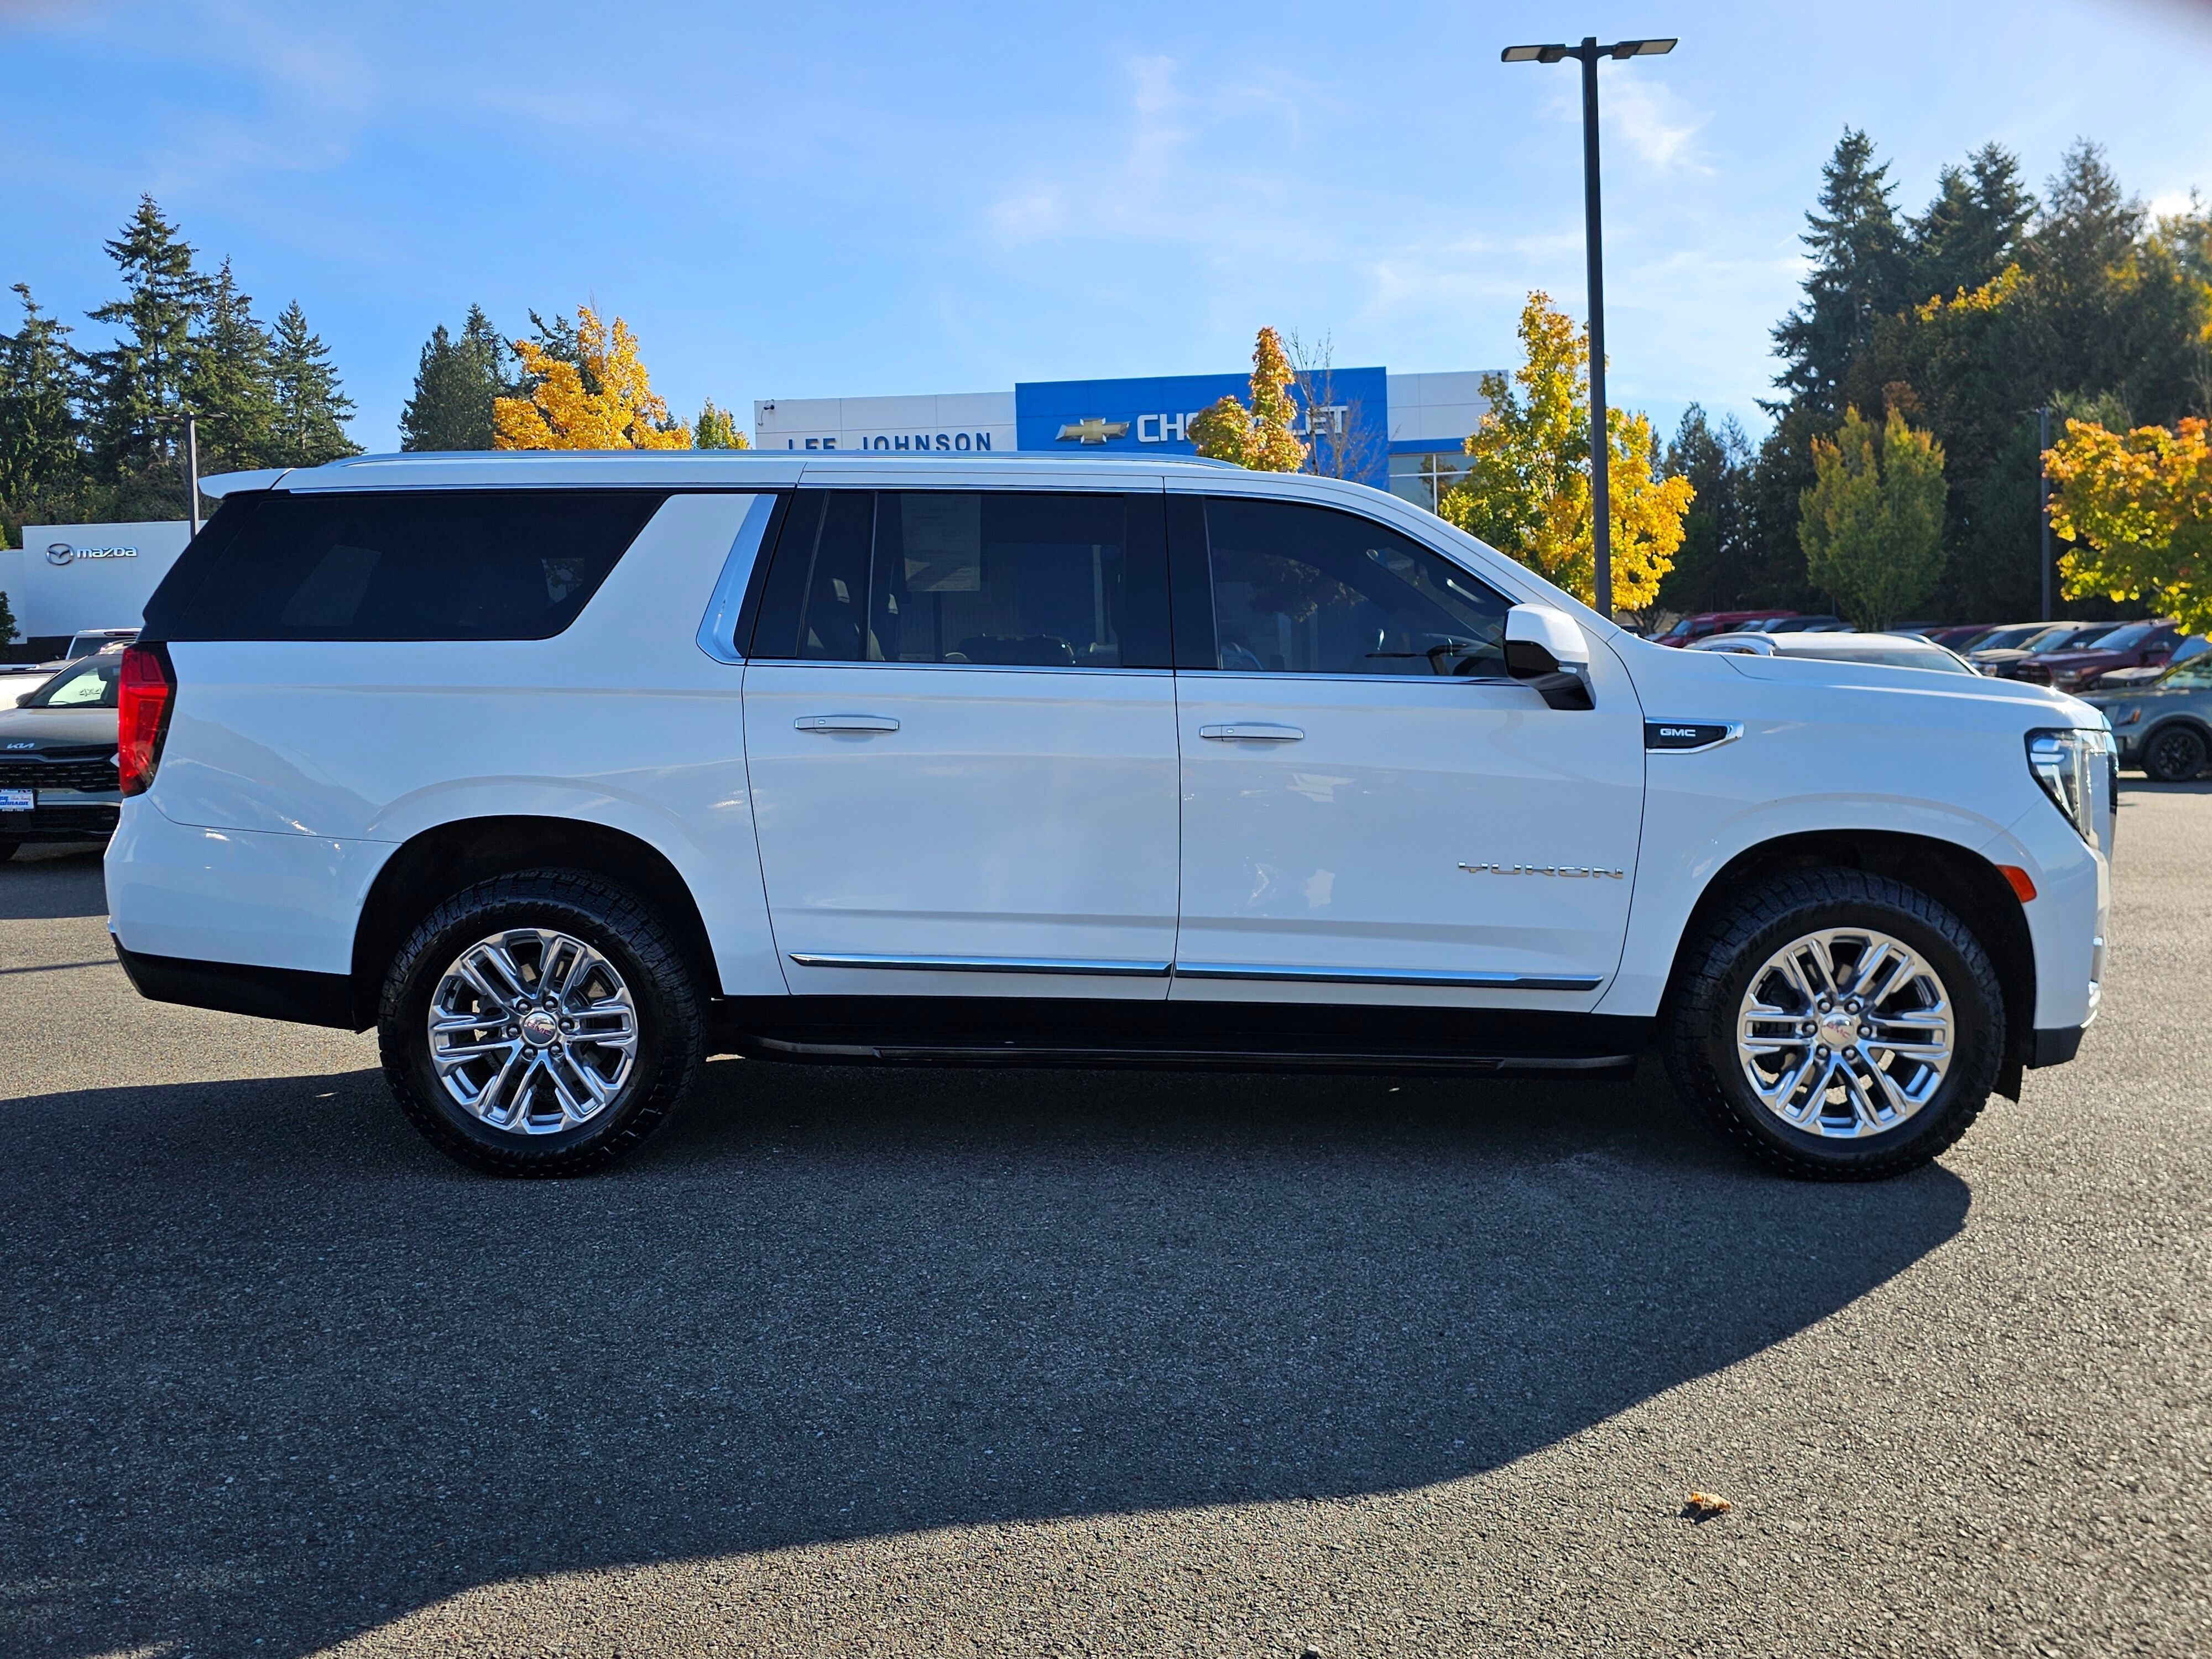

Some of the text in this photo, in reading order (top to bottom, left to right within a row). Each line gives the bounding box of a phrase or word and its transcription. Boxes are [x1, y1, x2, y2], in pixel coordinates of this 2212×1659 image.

[1137, 405, 1349, 442] CHLET
[1660, 728, 1696, 737] GMC
[1458, 861, 1624, 879] YUKON
[526, 1021, 552, 1036] GMC
[1827, 1021, 1850, 1039] GMC
